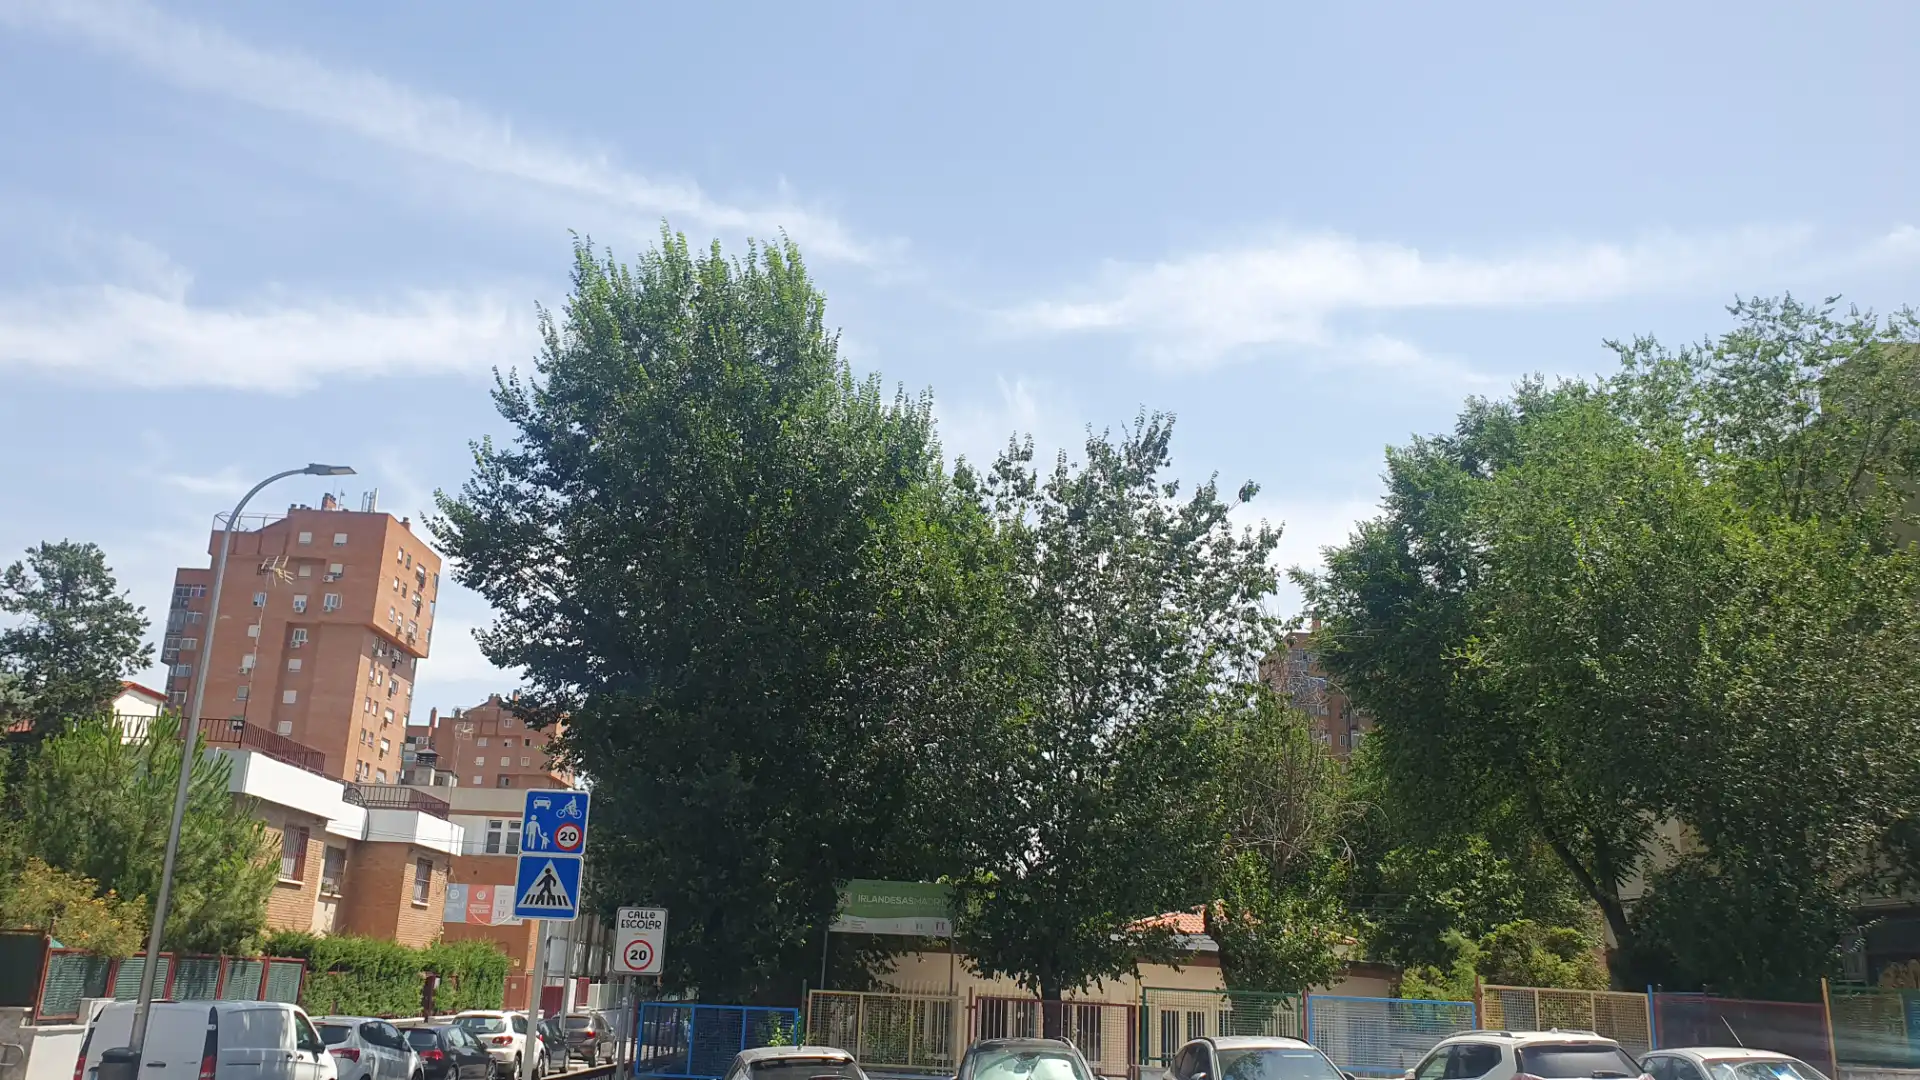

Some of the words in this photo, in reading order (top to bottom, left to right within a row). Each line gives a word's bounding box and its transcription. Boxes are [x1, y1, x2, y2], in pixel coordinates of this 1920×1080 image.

[560, 832, 576, 841] 20
[621, 920, 661, 930] ESCOLAR
[630, 950, 647, 960] 20
